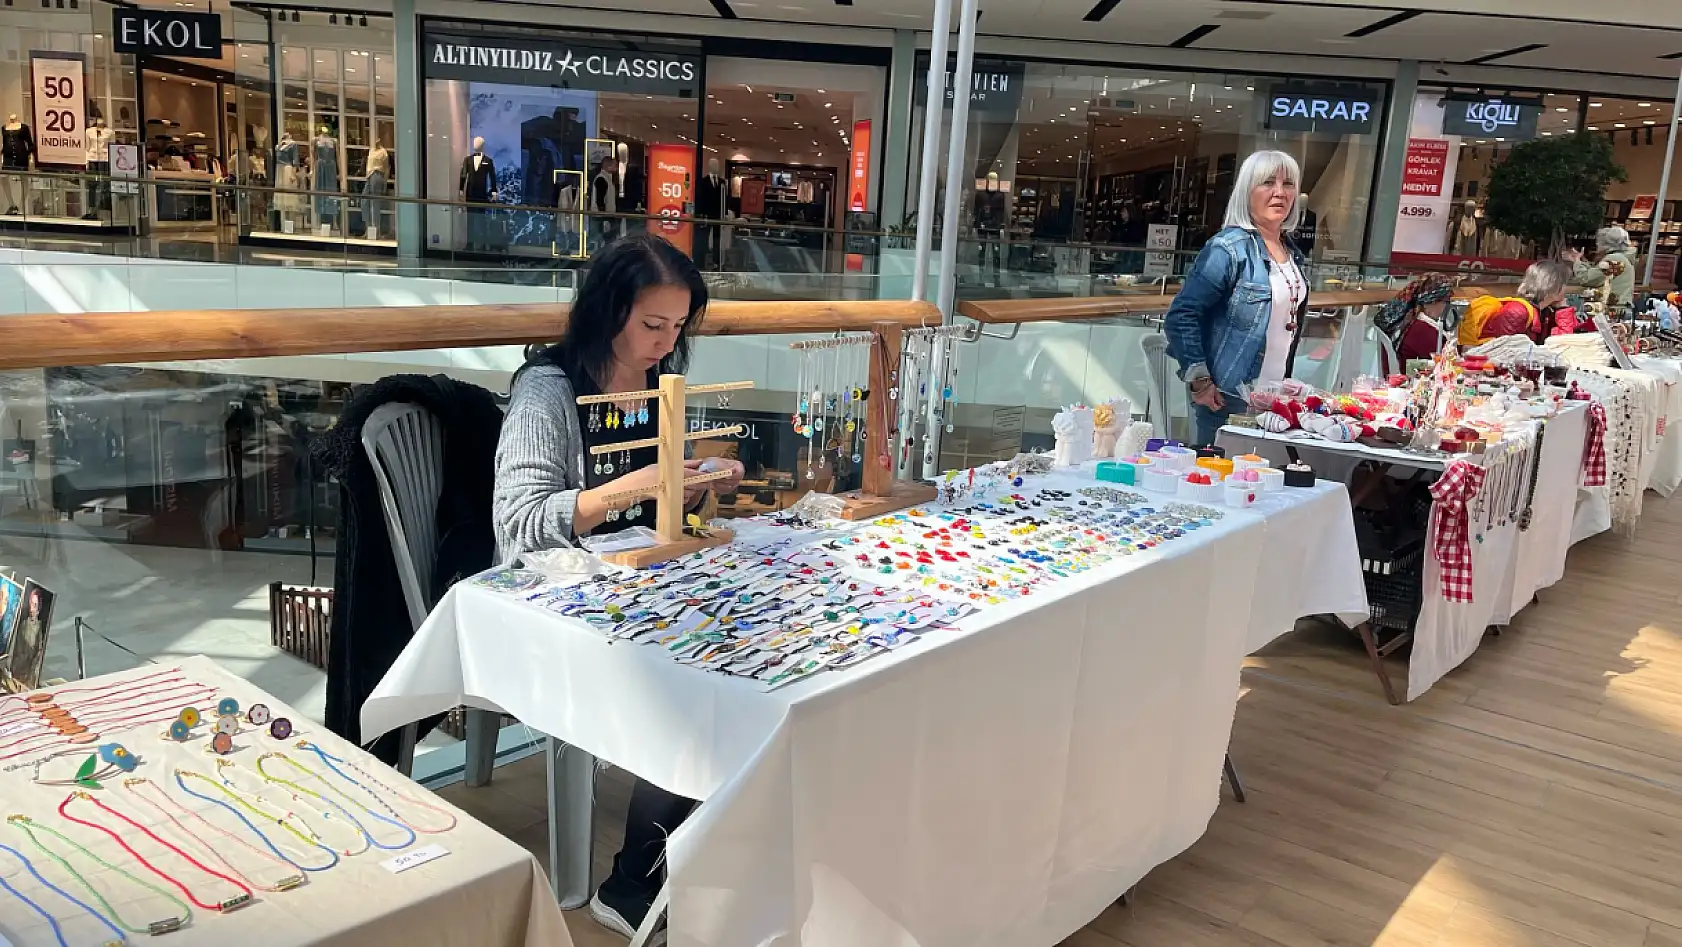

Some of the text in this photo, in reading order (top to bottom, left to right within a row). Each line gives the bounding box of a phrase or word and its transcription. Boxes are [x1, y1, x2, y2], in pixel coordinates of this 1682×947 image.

[121, 17, 213, 49] EKOL
[433, 43, 694, 81] ALTINYILDIZ CLASSICS
[946, 90, 986, 101] SAR
[1272, 97, 1370, 121] SARAR
[41, 135, 81, 149] İNDİRİM
[1400, 206, 1433, 217] 4.999
